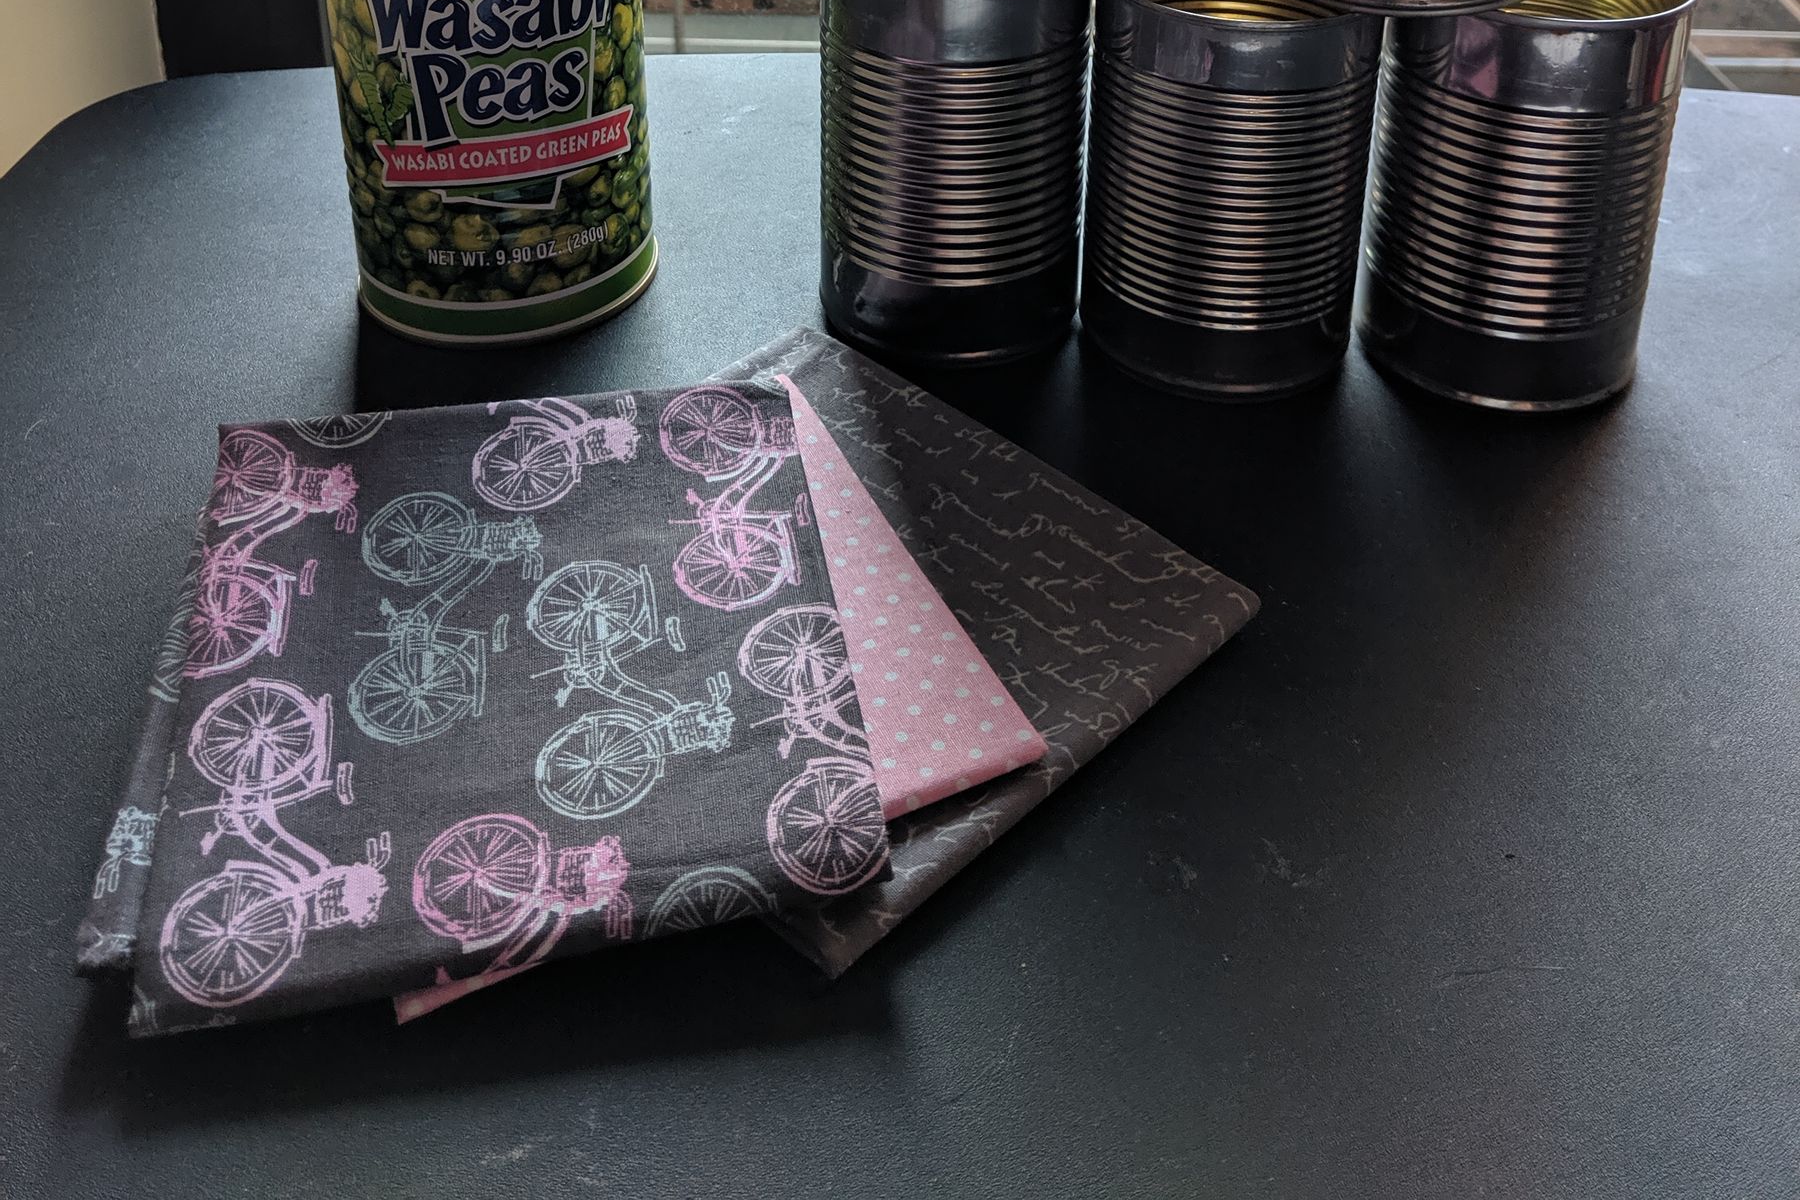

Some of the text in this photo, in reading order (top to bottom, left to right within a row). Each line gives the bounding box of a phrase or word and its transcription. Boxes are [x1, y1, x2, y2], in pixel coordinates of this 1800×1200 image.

[409, 48, 589, 142] Peas
[390, 121, 622, 171] WASABI COATED GREEN PEAS
[428, 221, 609, 268] NET WT. 9.90 OZ. (280g)
